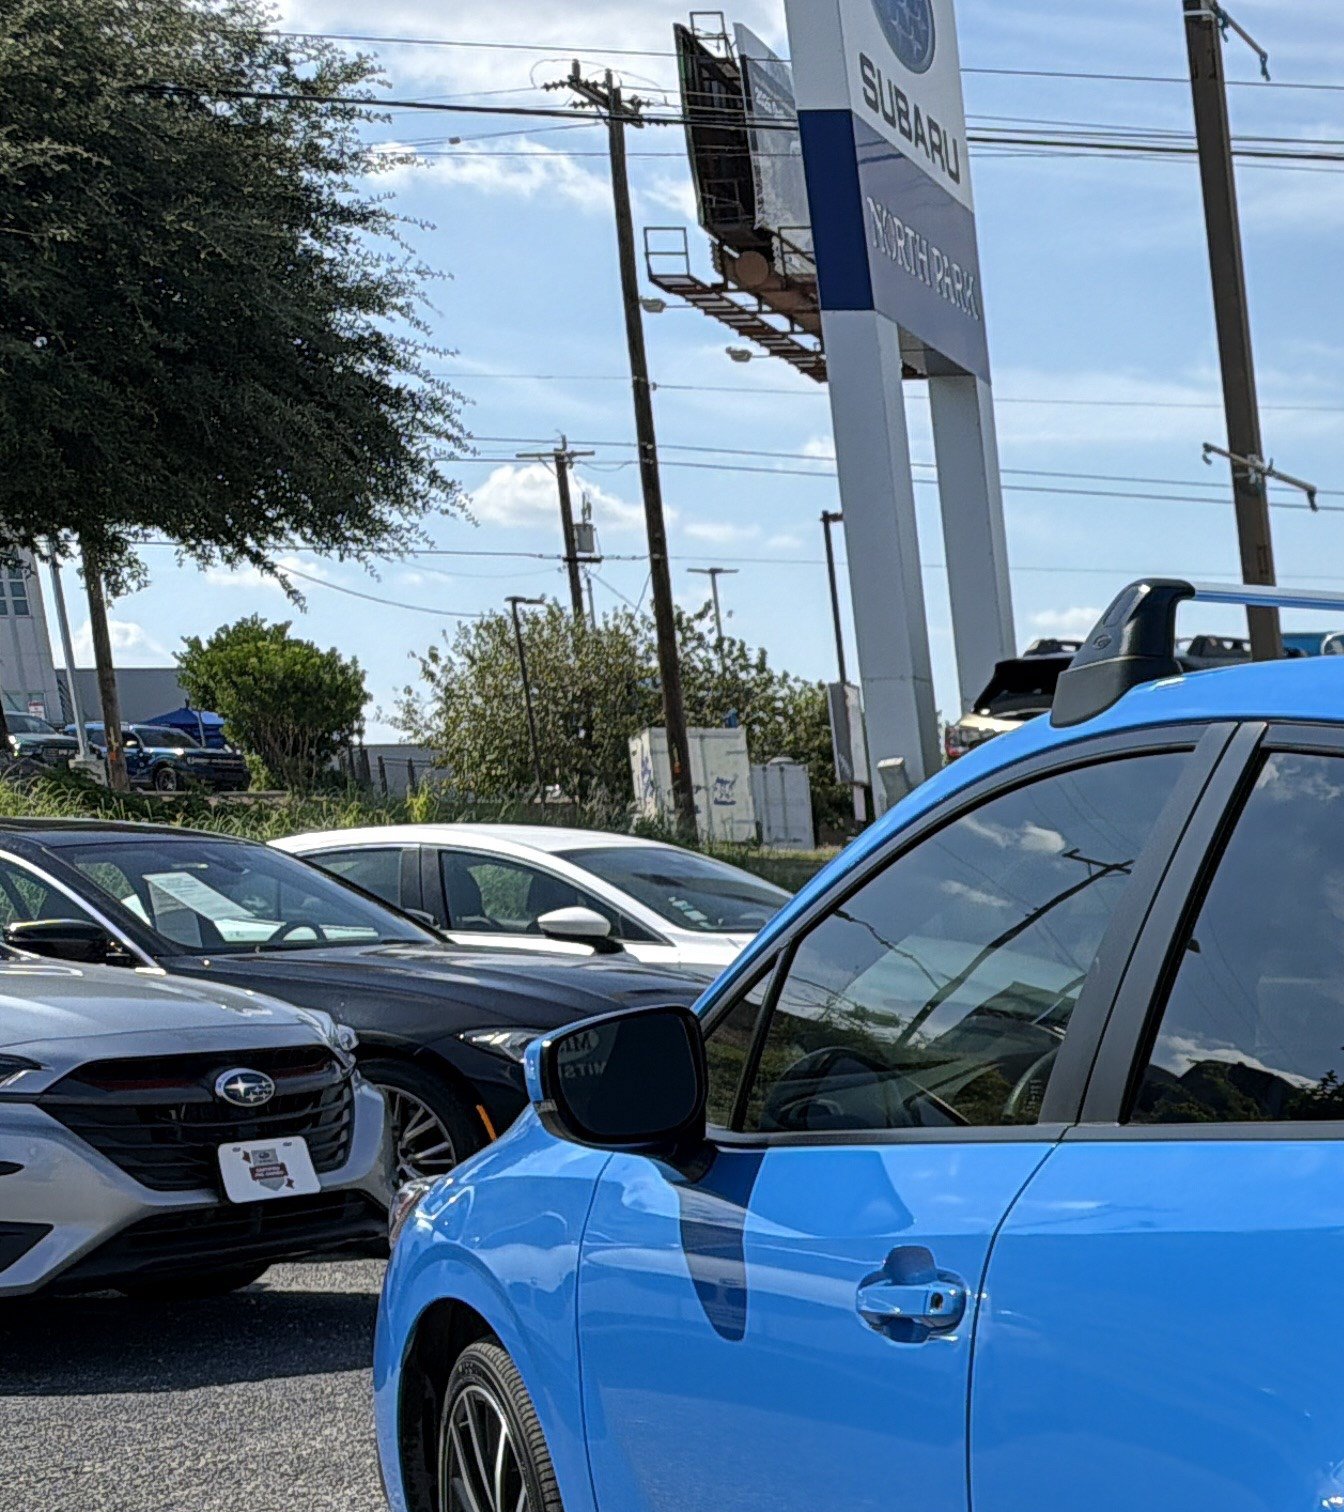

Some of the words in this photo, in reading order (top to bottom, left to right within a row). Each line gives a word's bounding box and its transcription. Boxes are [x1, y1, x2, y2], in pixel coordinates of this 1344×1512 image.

[859, 52, 961, 185] SUBARU
[866, 196, 932, 288] NORTH
[931, 246, 980, 321] PARK
